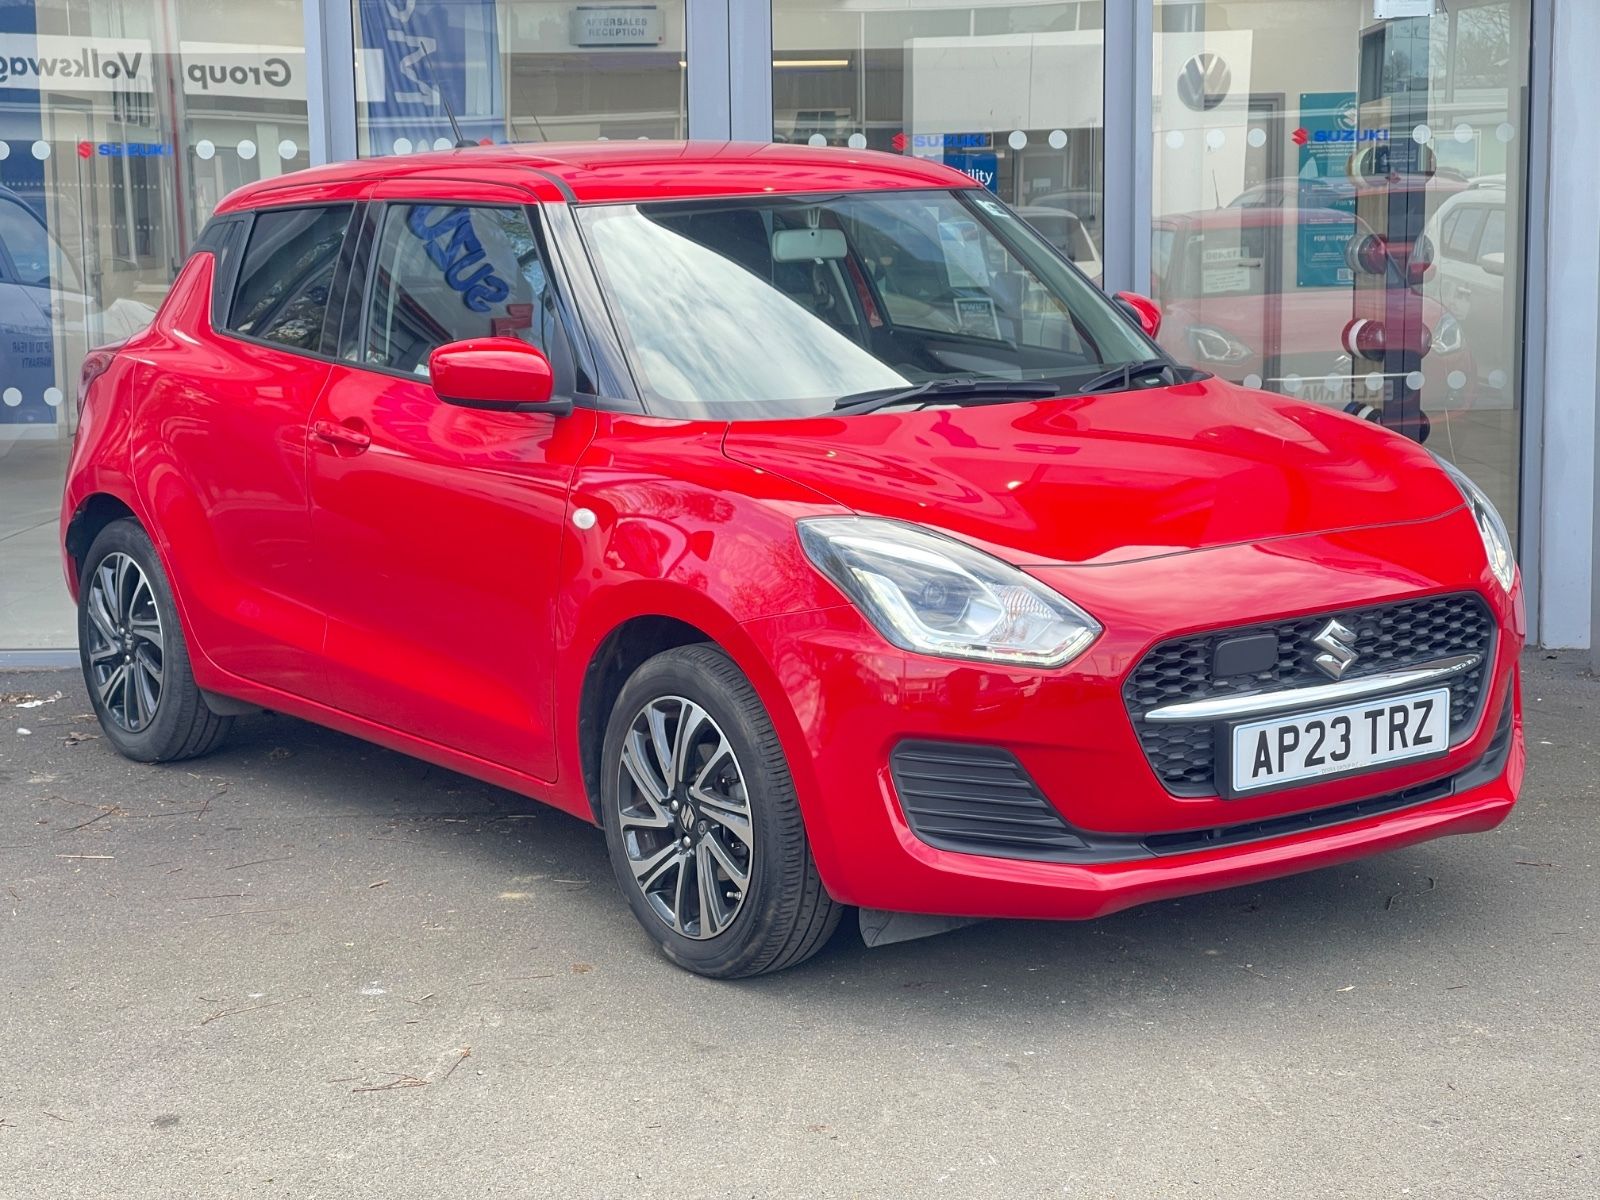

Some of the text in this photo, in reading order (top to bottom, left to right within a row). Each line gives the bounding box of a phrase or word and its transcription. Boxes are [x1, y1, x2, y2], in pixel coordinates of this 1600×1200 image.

[585, 18, 647, 26] AFTERSALES
[588, 28, 645, 37] RECEPTION
[914, 133, 986, 147] SUZUKI
[1314, 128, 1389, 142] SUZUKI
[98, 143, 174, 156] SUZUKI
[960, 168, 994, 186] ility
[1251, 699, 1434, 778] AP23 TRZ
